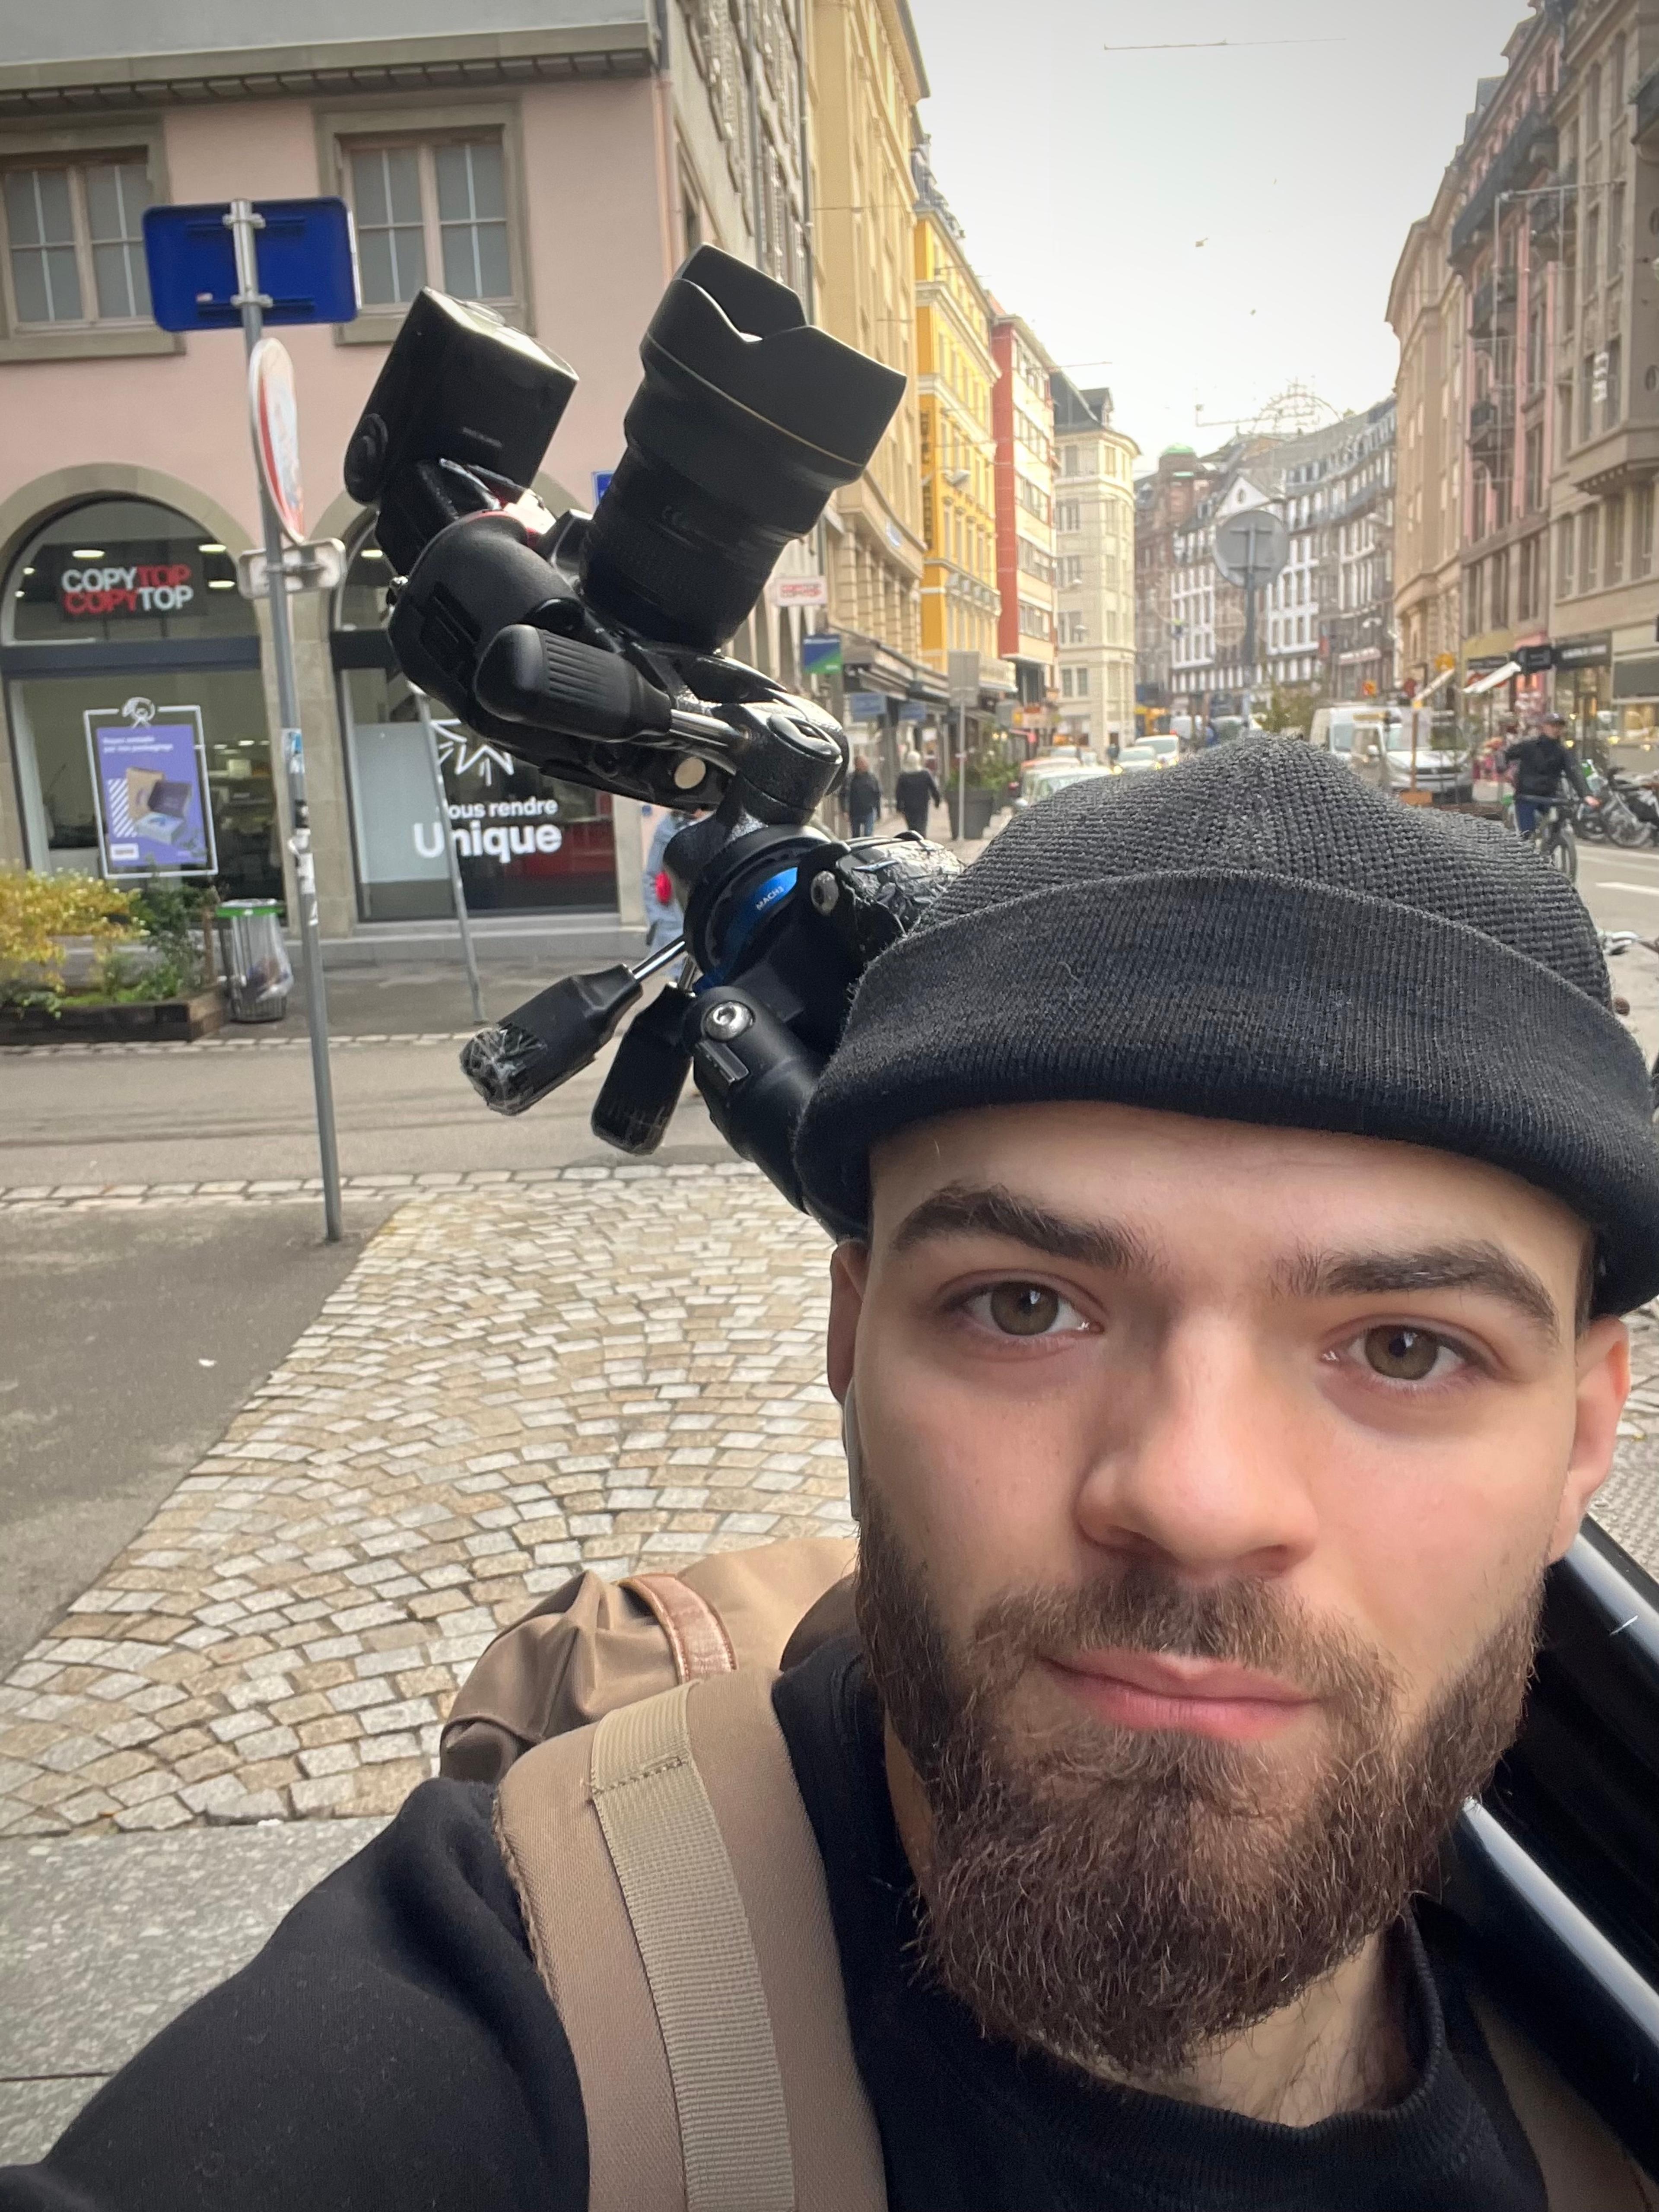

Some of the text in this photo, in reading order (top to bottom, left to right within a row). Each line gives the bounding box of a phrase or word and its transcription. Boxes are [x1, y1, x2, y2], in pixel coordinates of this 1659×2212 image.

[435, 796, 558, 819] ous rendre
[413, 820, 562, 864] Unique
